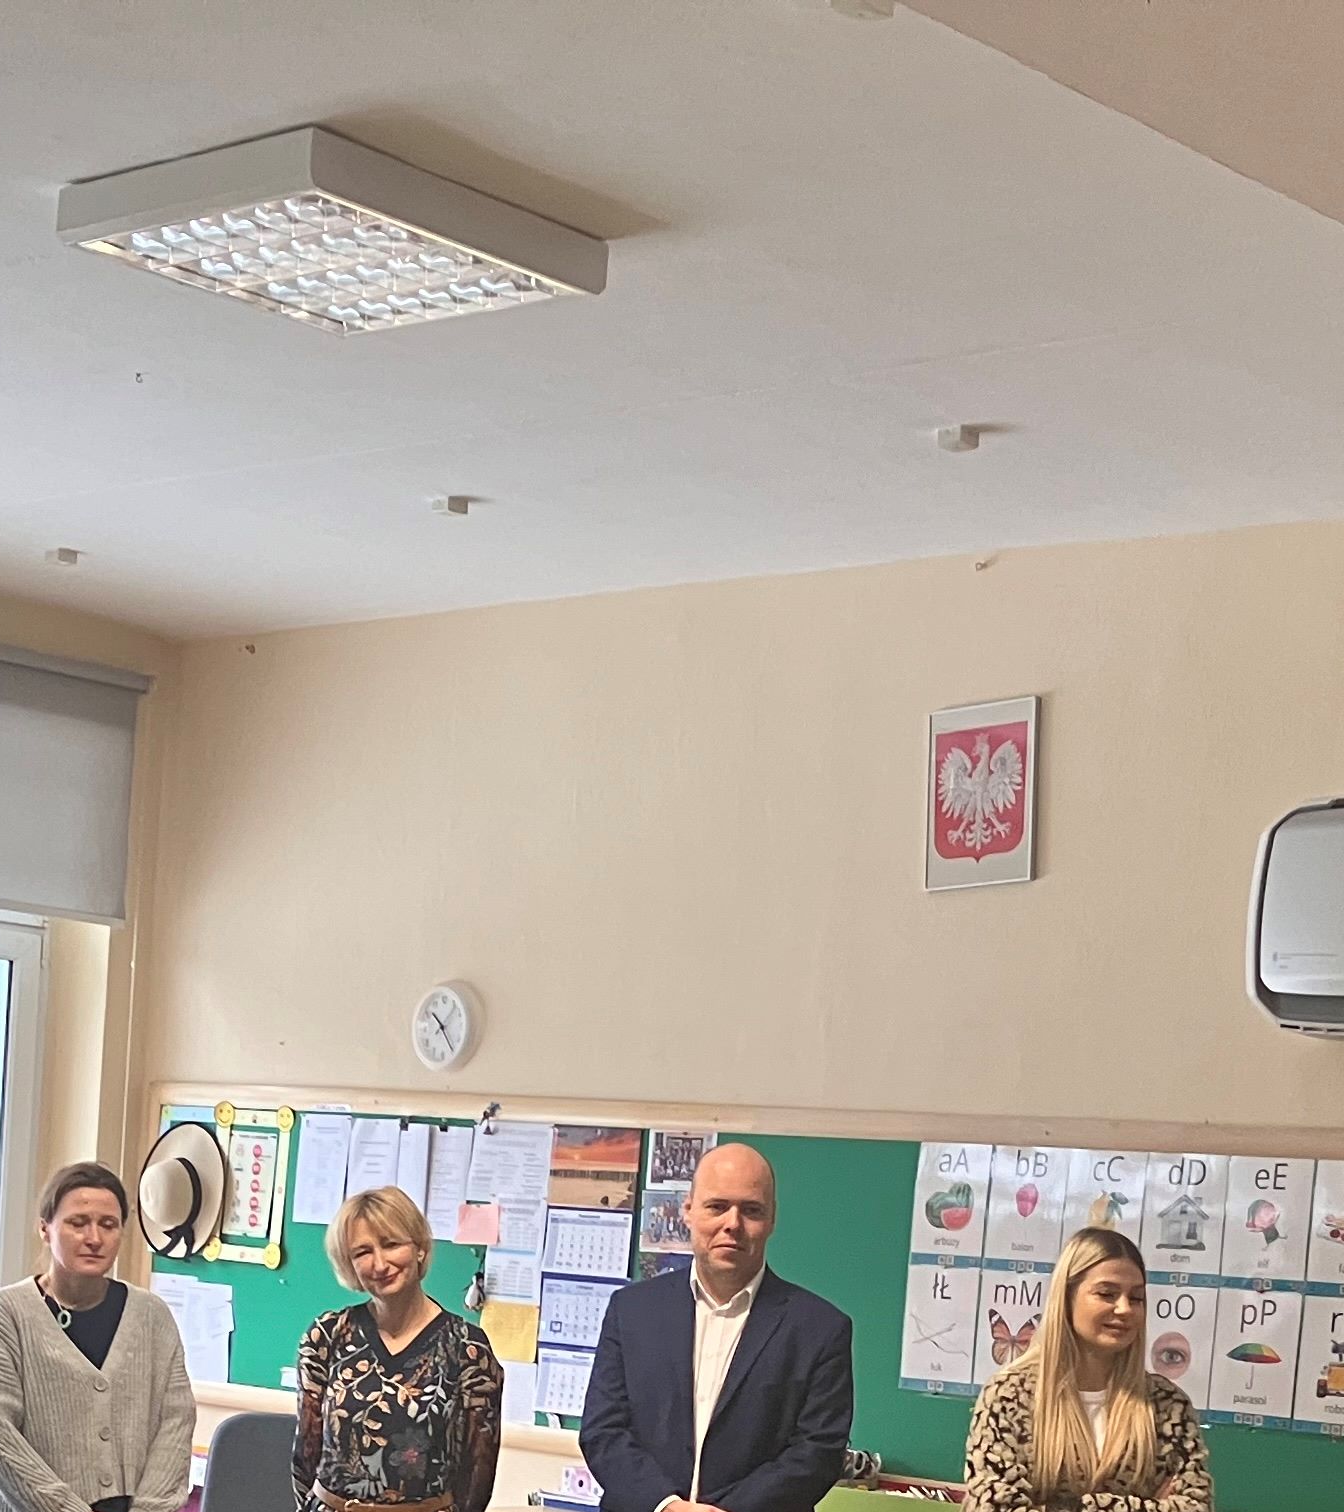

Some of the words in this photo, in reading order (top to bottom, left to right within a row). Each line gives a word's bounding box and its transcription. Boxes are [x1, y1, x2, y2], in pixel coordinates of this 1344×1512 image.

[939, 1148, 969, 1173] aA
[1016, 1150, 1049, 1178] bB
[1093, 1156, 1125, 1183] cC
[1168, 1157, 1206, 1187] dD
[1255, 1163, 1289, 1190] eE
[1170, 1253, 1190, 1264] dom
[932, 1272, 952, 1300] łŁ
[994, 1280, 1042, 1308] mM
[1156, 1293, 1196, 1321] oO
[1240, 1299, 1277, 1333] pP
[1233, 1394, 1267, 1407] parasol
